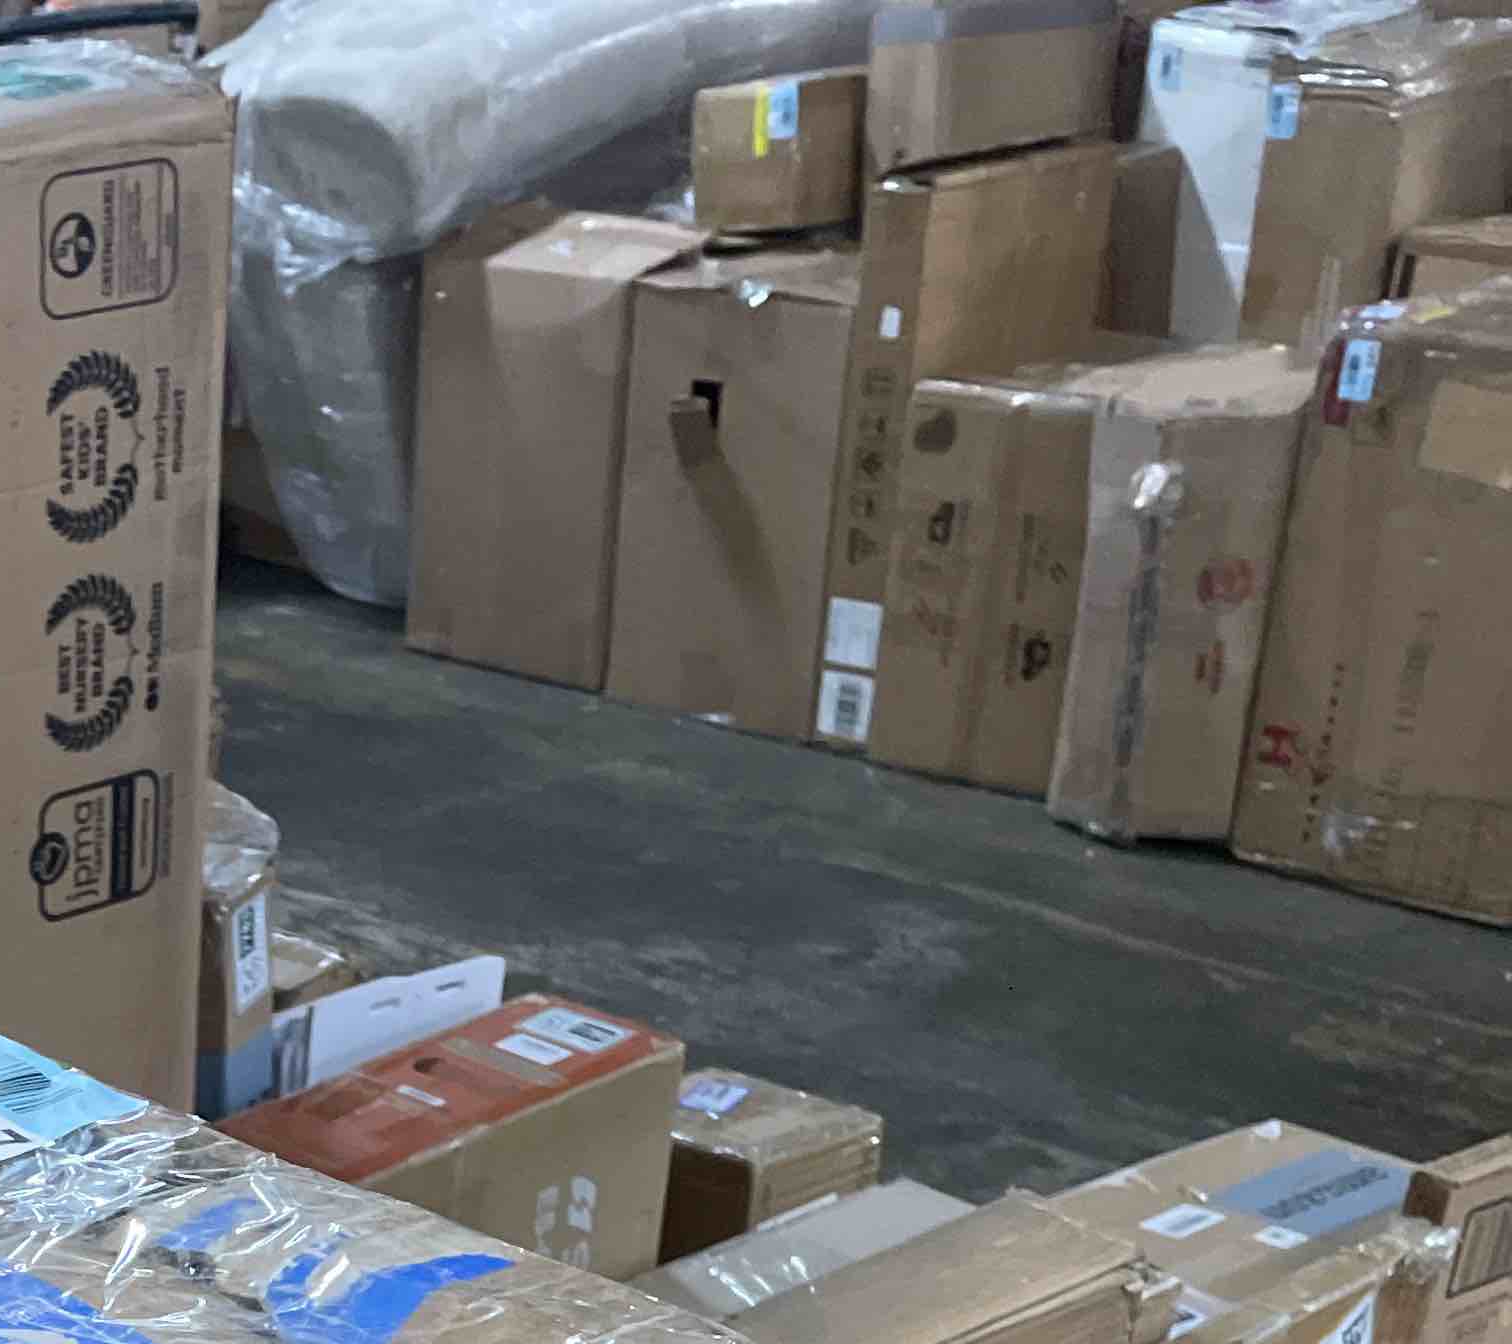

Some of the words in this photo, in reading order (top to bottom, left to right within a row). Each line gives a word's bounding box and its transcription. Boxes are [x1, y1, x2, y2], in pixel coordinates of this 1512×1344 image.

[59, 412, 75, 496] SAFEST
[93, 405, 109, 488] BRAND
[57, 643, 71, 695] BEST
[74, 617, 88, 713] NURSERY
[90, 622, 105, 698] BRAND
